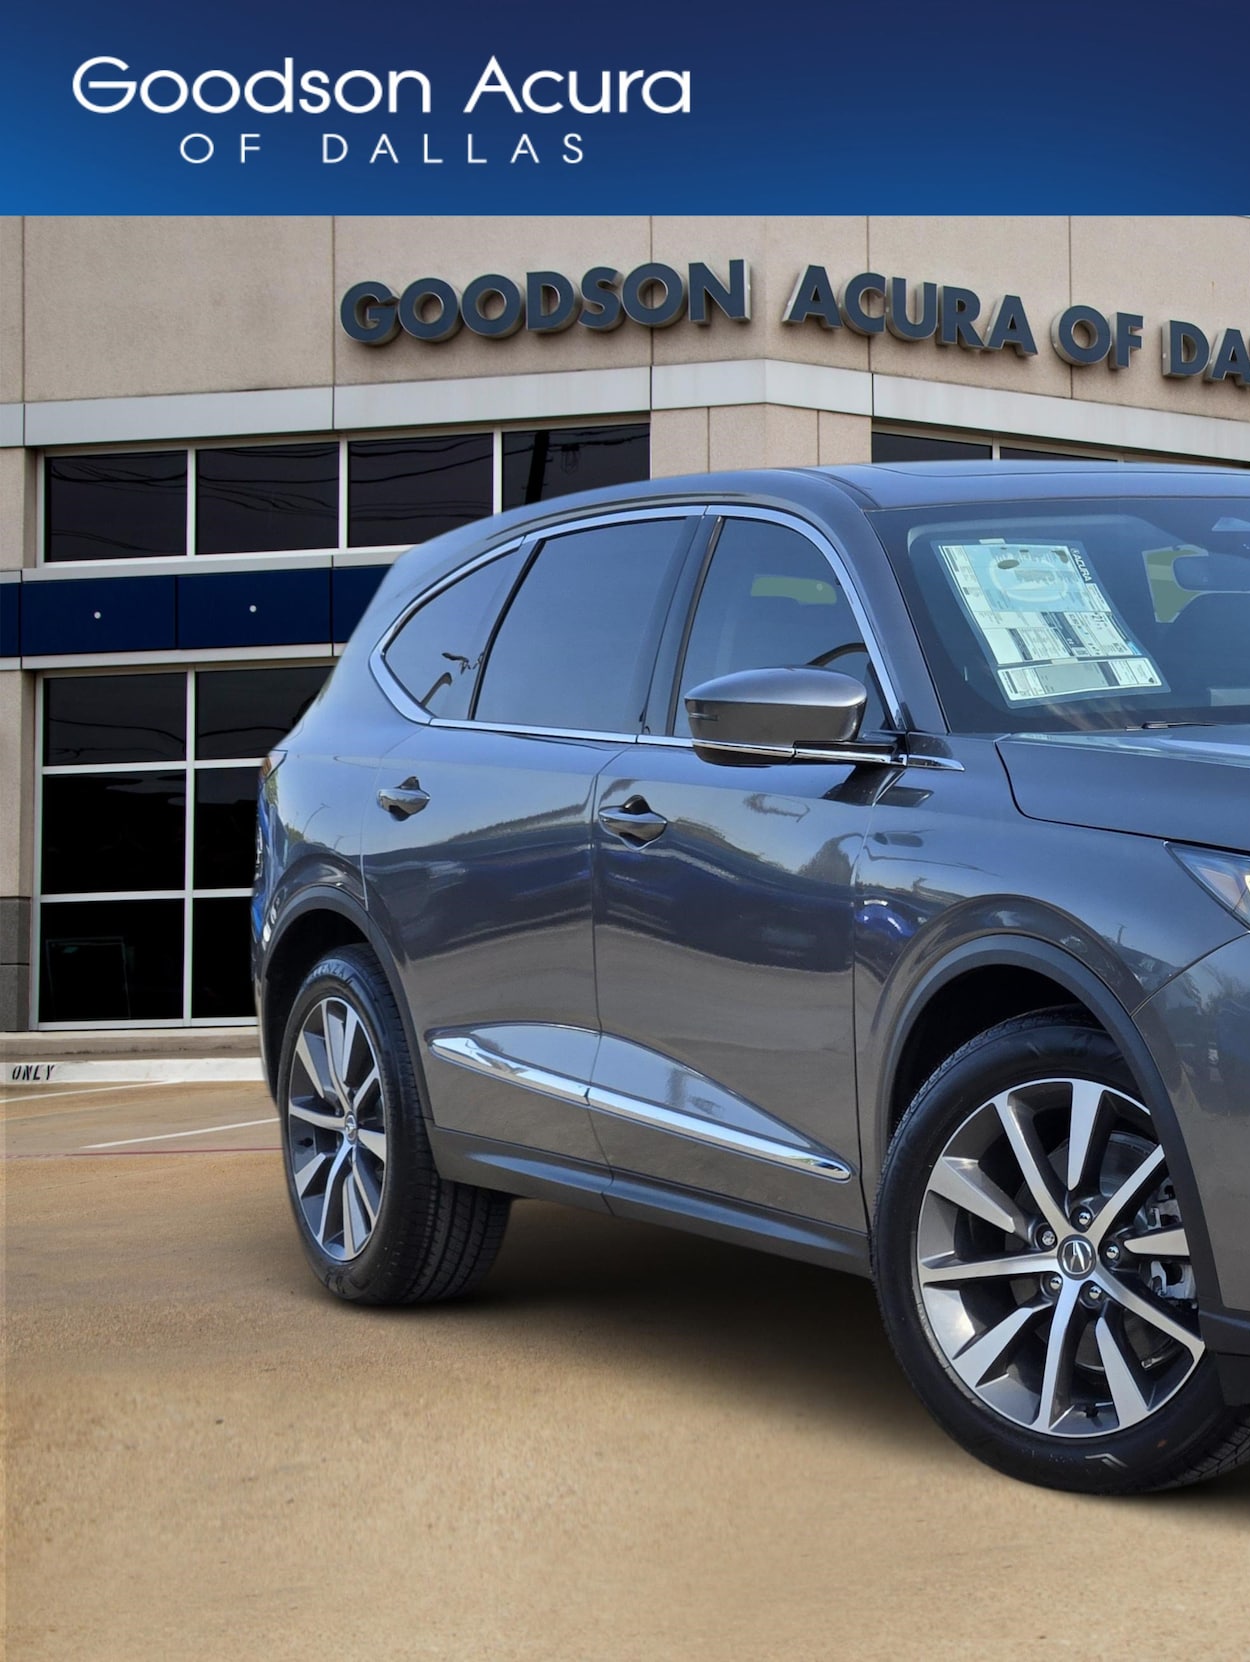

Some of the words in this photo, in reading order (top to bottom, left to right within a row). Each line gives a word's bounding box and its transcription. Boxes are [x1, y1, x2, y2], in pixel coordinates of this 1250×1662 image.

[340, 259, 752, 346] GOODSON
[783, 264, 1039, 358] ACURA
[1052, 304, 1144, 369] OF
[1073, 553, 1093, 582] ACURA
[12, 1064, 55, 1081] ONLY
